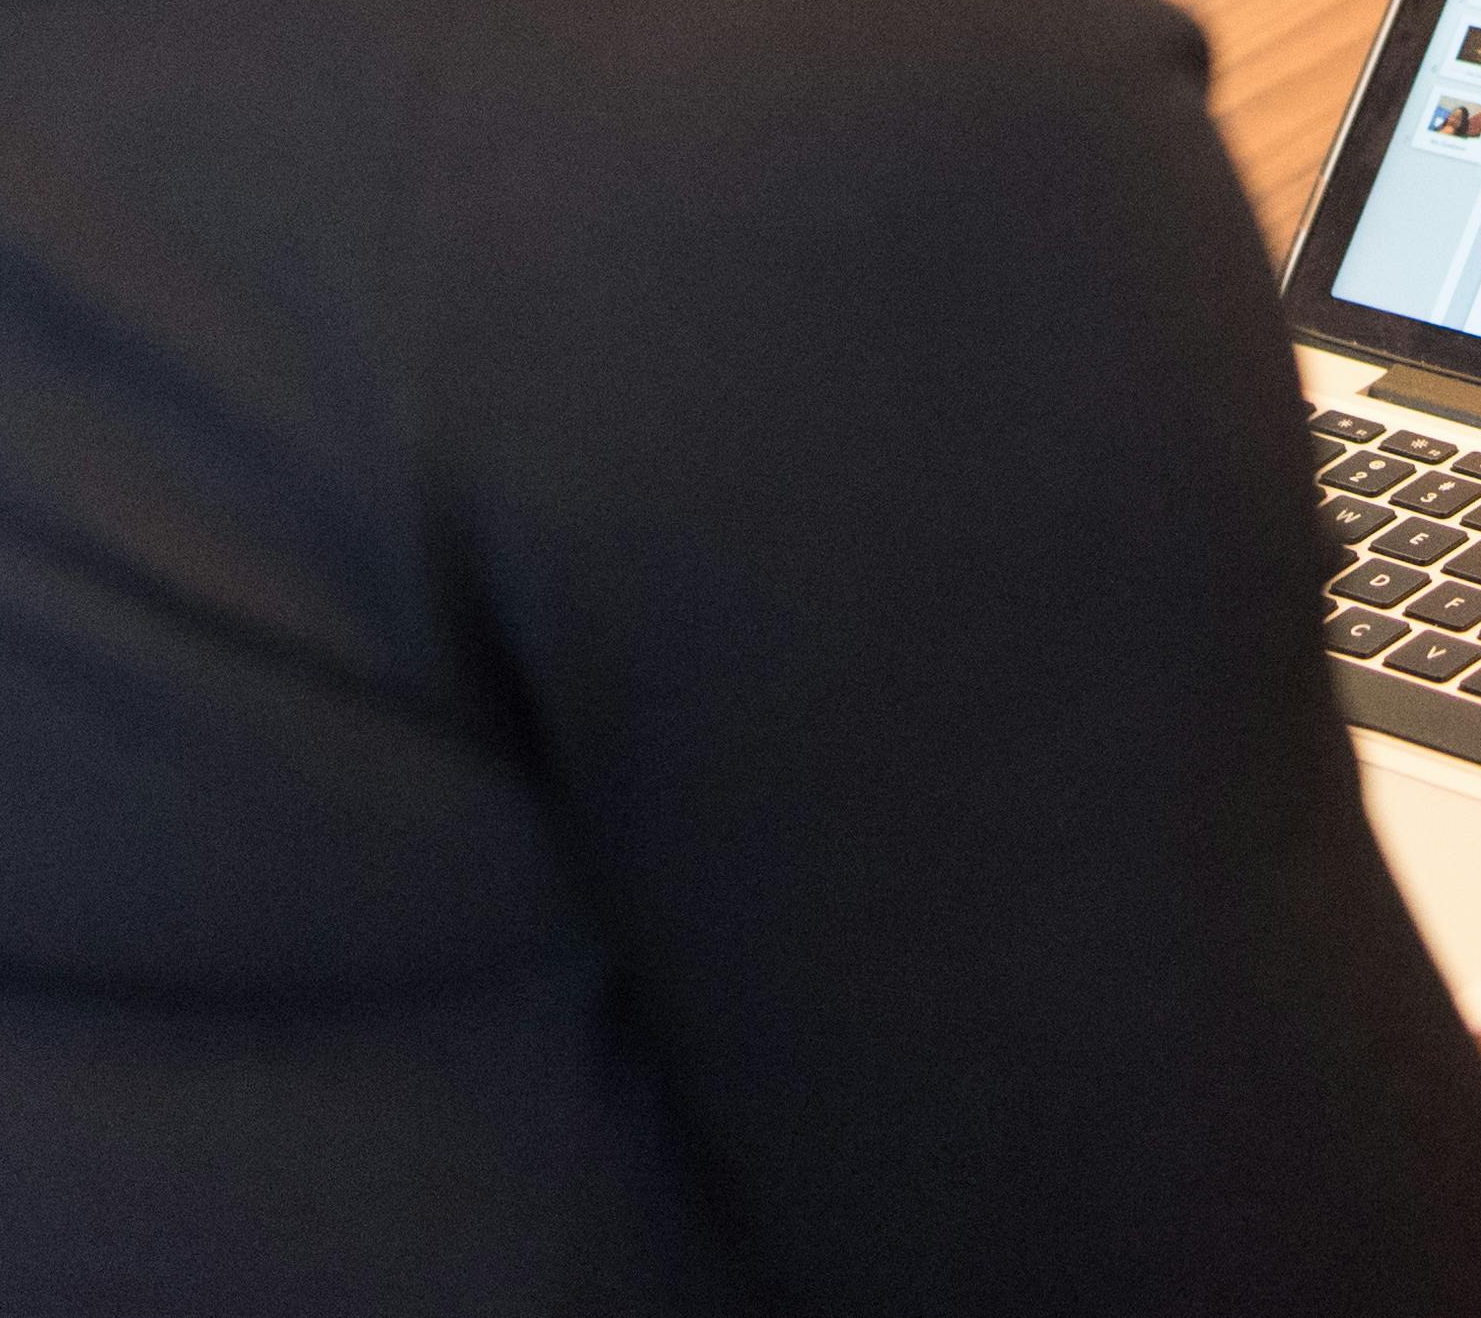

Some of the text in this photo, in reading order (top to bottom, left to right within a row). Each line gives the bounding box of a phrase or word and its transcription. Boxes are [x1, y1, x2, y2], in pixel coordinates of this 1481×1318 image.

[1337, 510, 1361, 523] W
[1410, 533, 1429, 544] E
[1370, 574, 1390, 586] D
[1445, 598, 1465, 608] F
[1351, 624, 1370, 636] C
[1427, 646, 1446, 659] V
